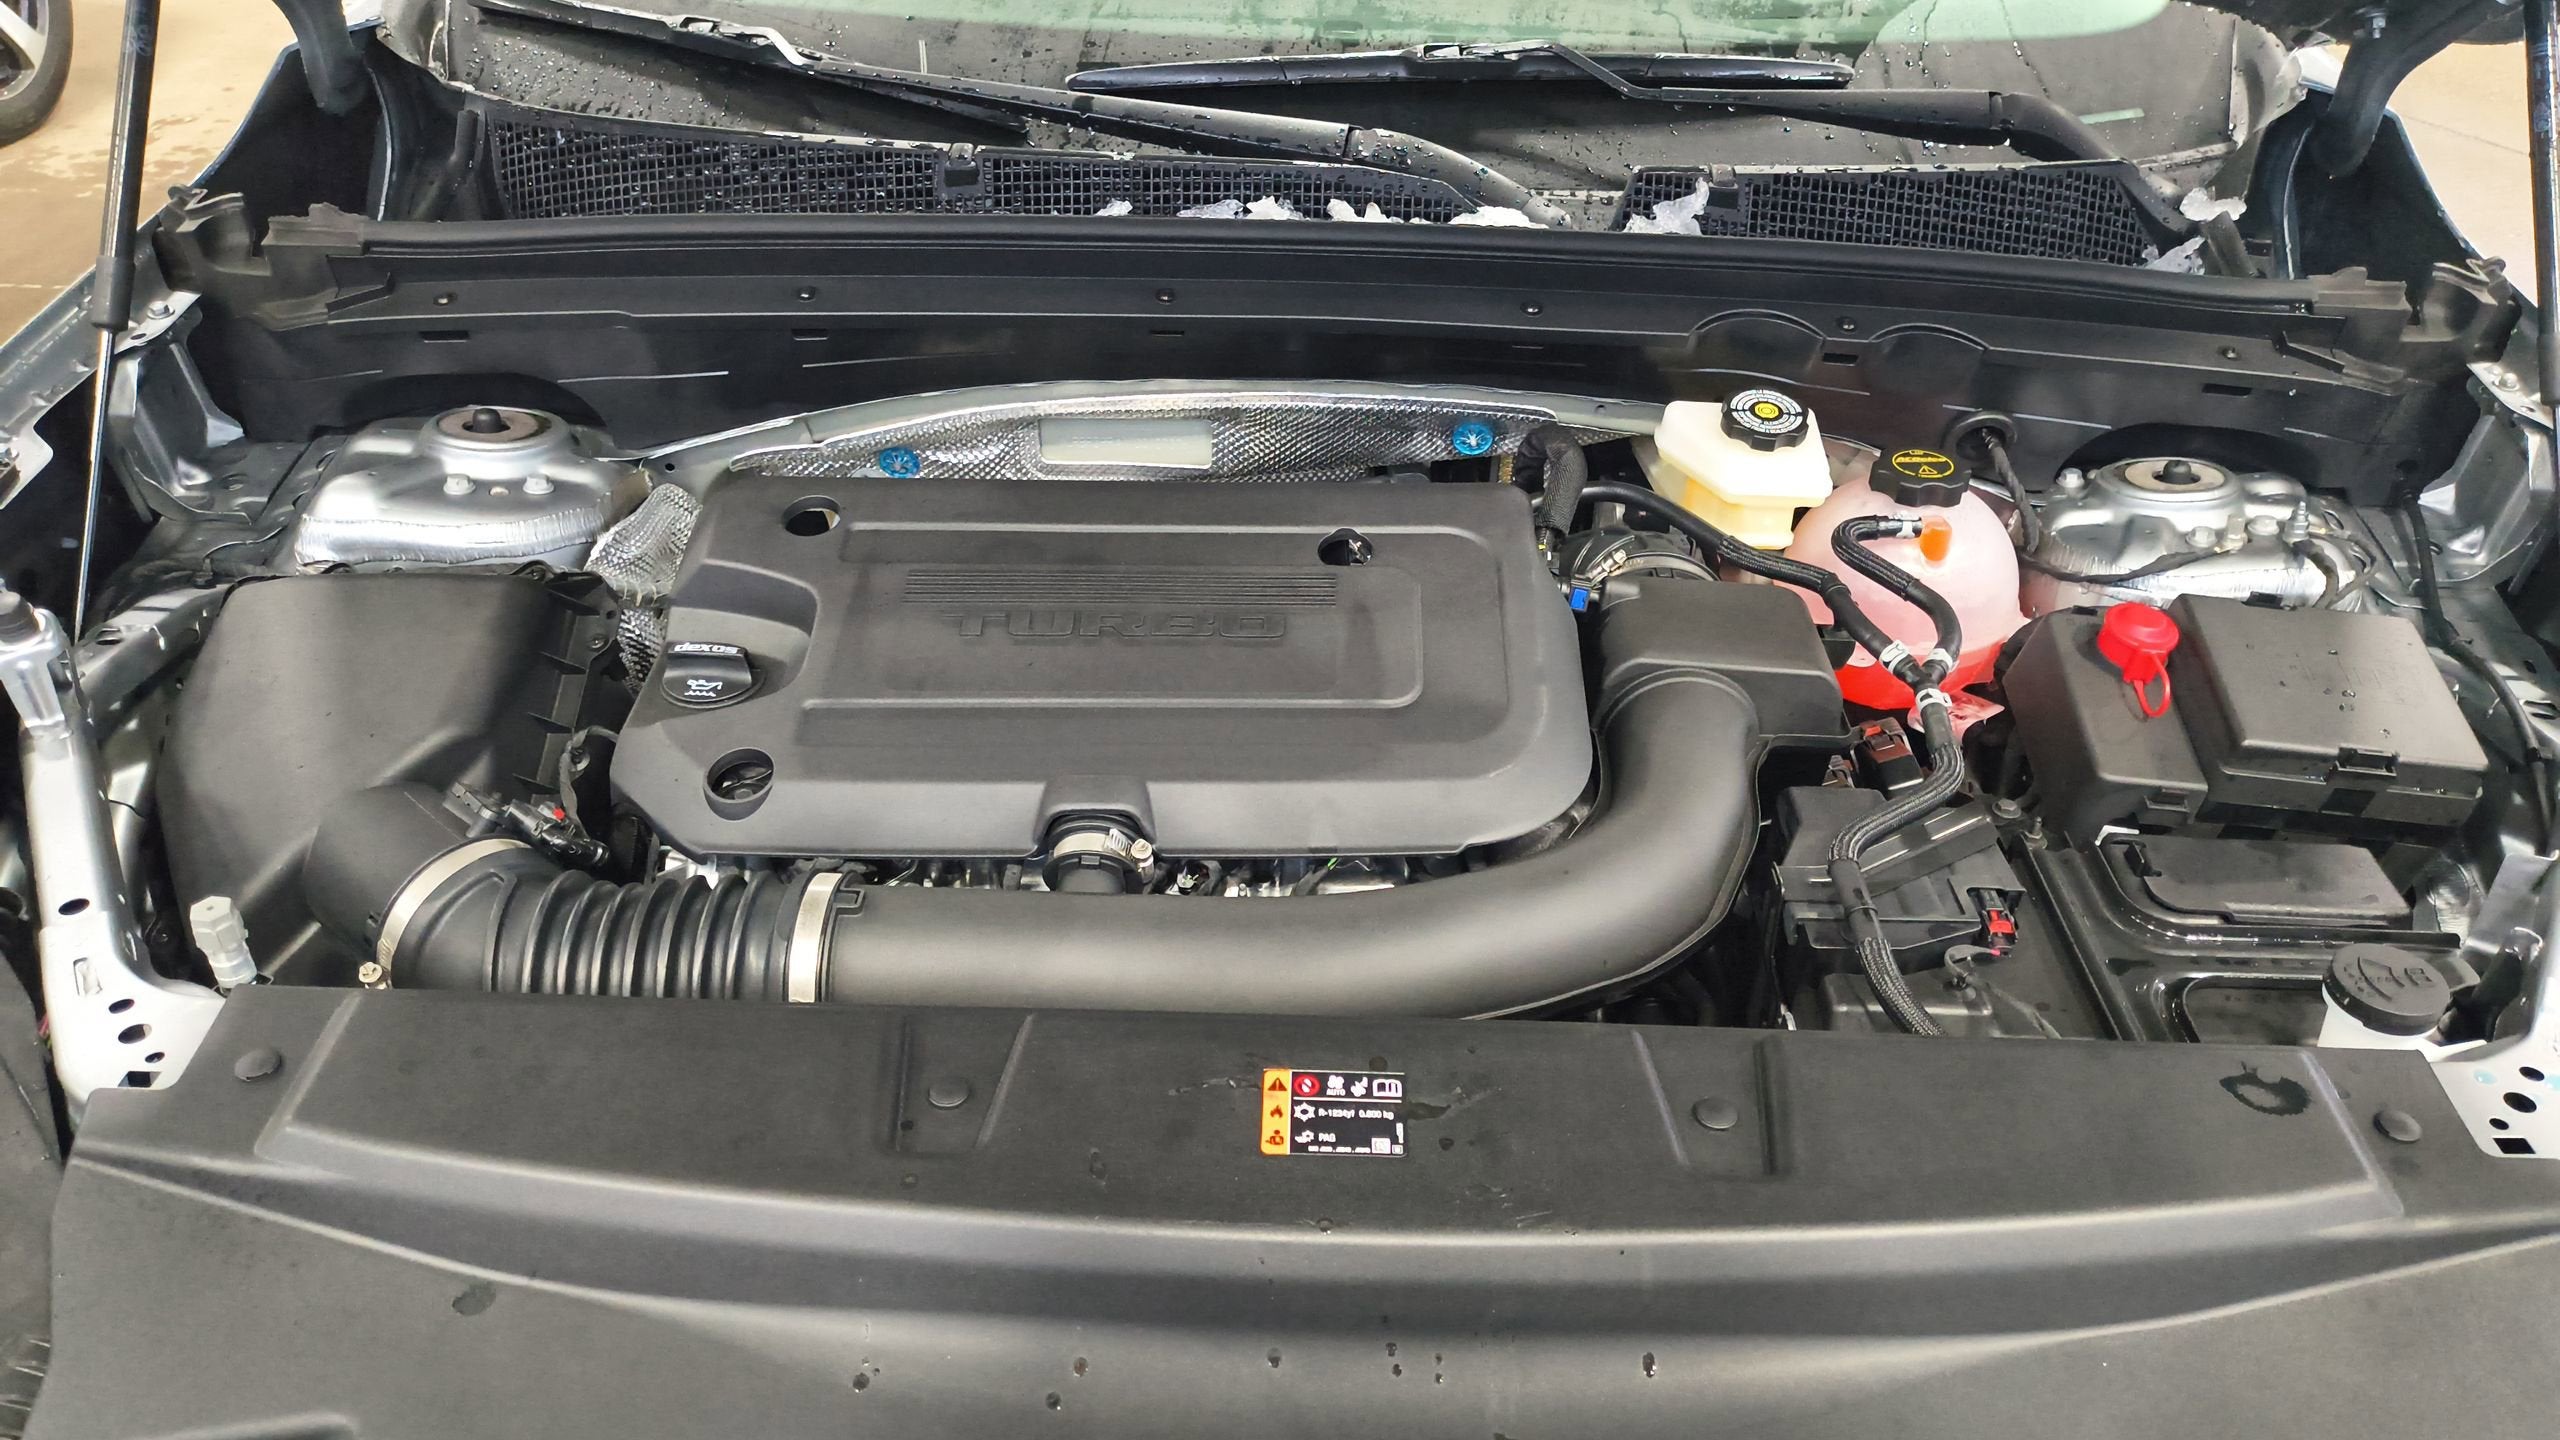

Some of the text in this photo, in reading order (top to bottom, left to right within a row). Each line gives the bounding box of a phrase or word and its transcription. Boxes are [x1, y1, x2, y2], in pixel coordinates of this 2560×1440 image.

[942, 611, 1286, 638] TURBO
[674, 642, 741, 654] dexos
[1326, 1088, 1346, 1096] AUTO
[1383, 1110, 1394, 1120] kg
[1319, 1133, 1336, 1142] PAG
